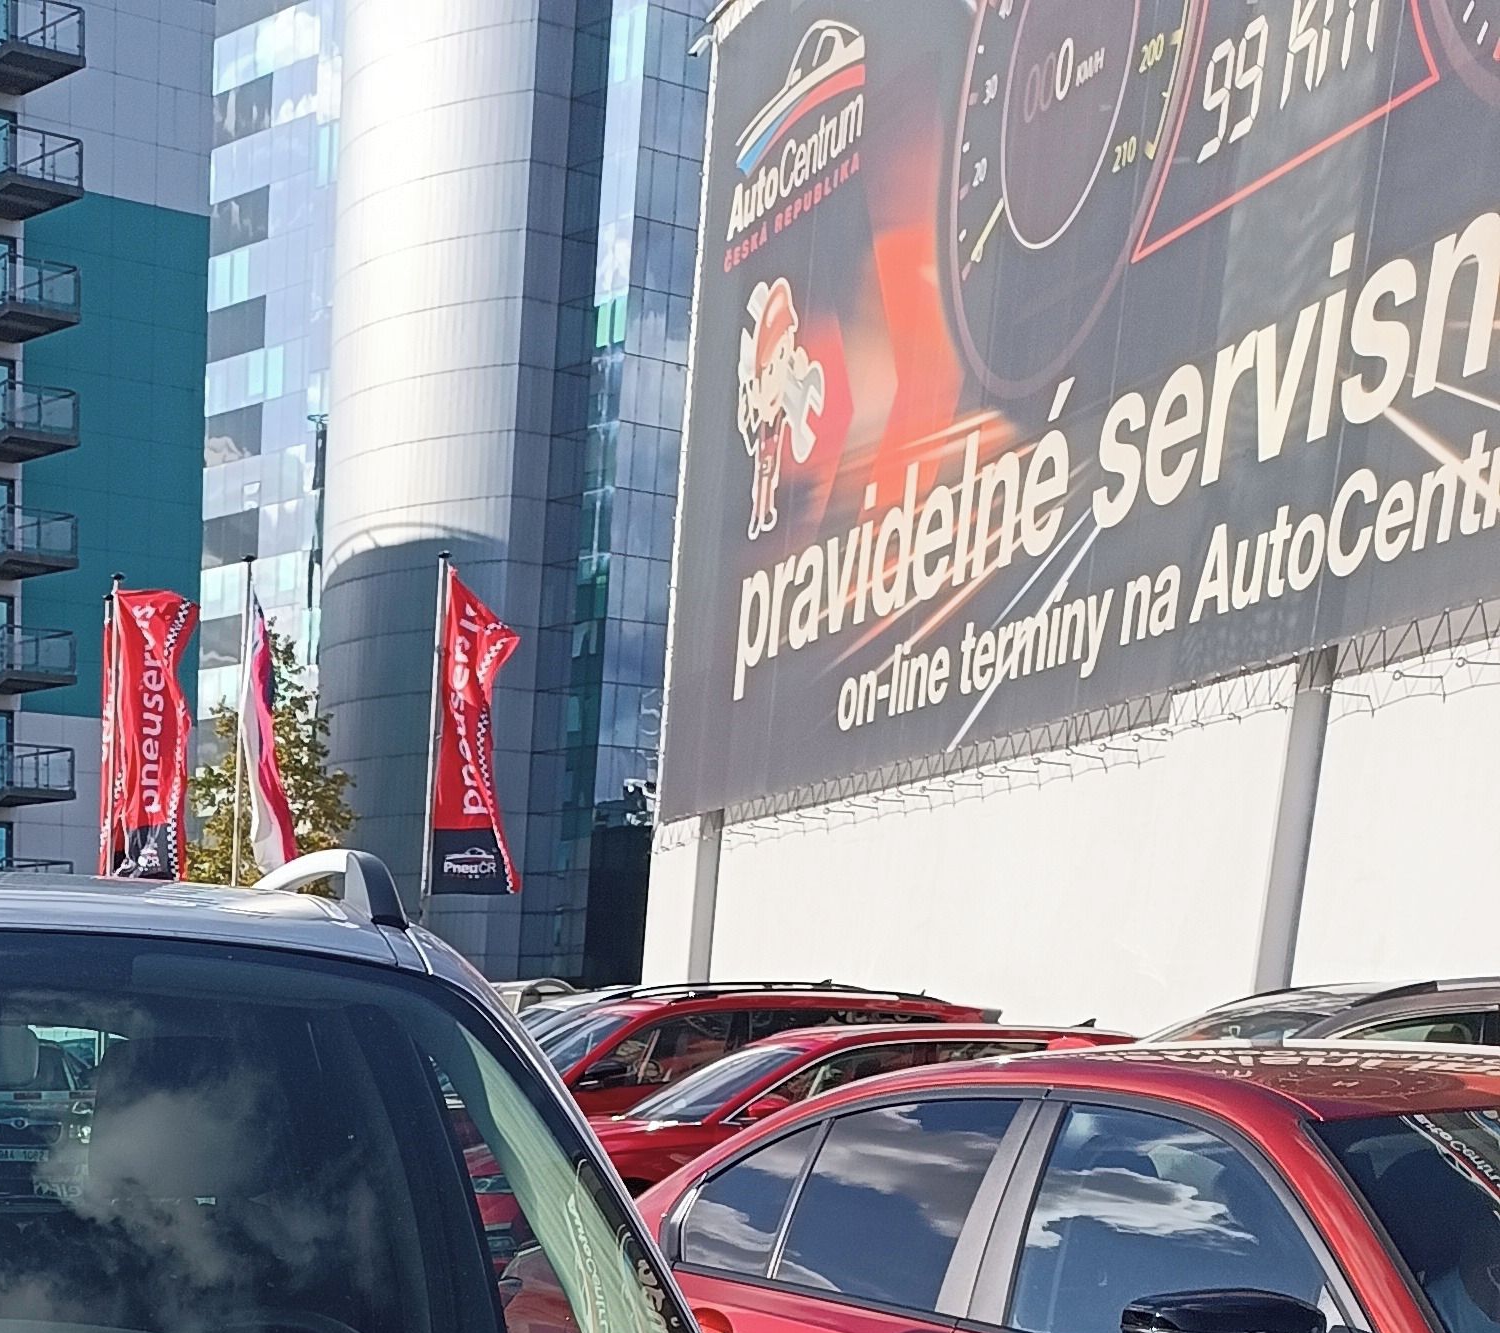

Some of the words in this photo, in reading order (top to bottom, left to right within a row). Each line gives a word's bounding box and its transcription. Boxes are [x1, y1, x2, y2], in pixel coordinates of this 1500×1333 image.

[1139, 33, 1165, 73] 200
[1197, 15, 1268, 163] 99
[726, 93, 864, 242] AutoCentrum
[774, 152, 861, 234] REPUBLIKA
[1112, 135, 1137, 174] 210
[733, 376, 1075, 699] pravidelné
[1092, 211, 1500, 528] servisn
[836, 640, 950, 732] on-line
[959, 576, 1115, 678] termíny
[1120, 564, 1180, 645] na
